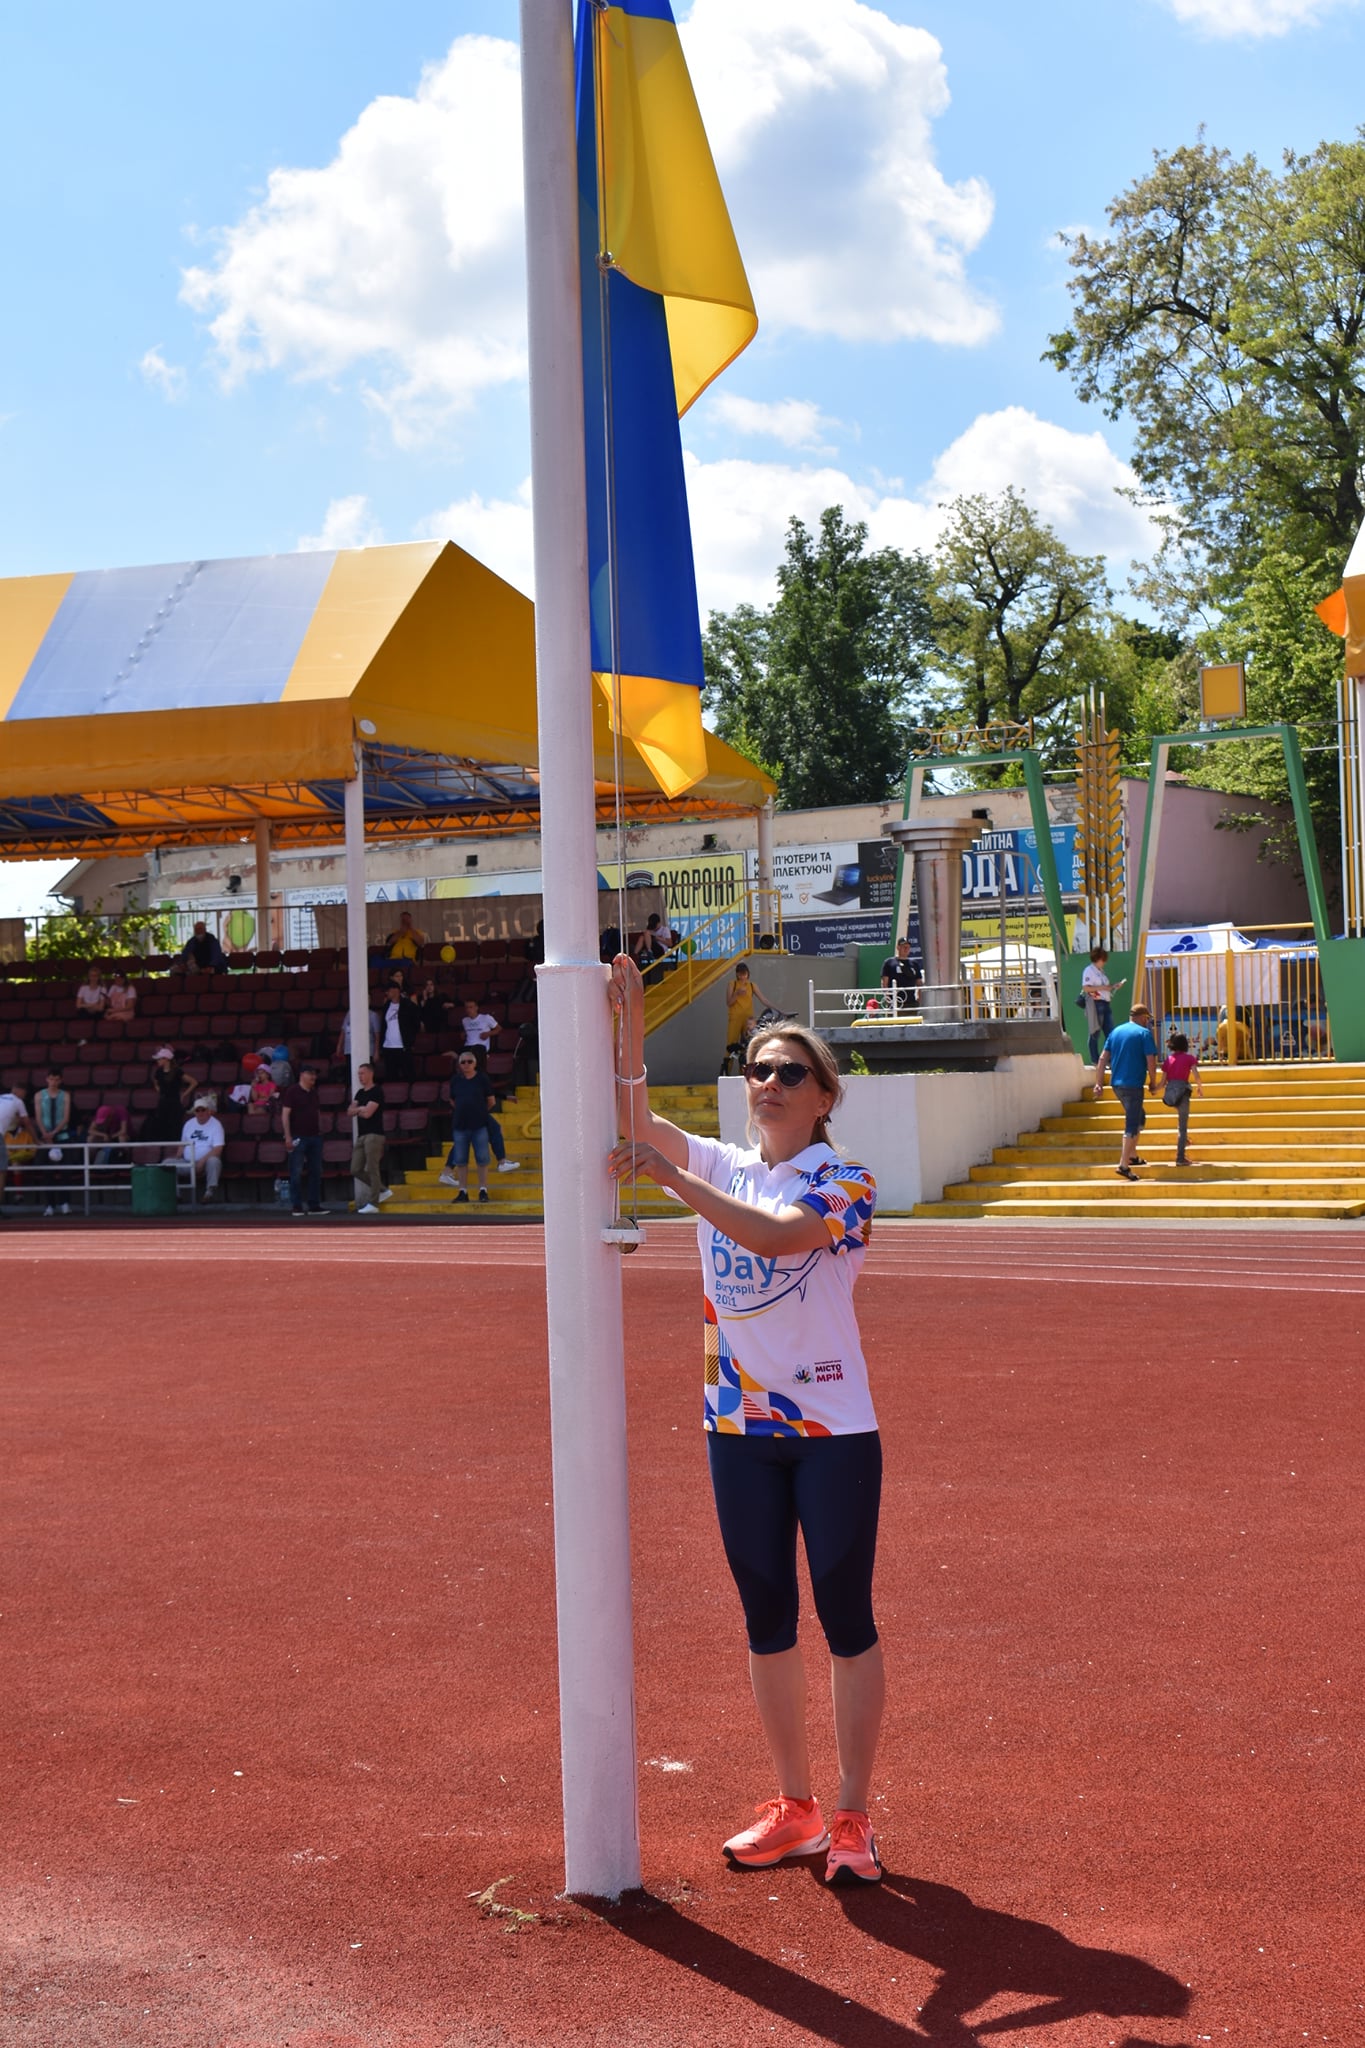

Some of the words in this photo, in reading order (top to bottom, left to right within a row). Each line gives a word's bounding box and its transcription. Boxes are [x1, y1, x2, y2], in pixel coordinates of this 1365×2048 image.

[976, 833, 1014, 851] ПИТНА
[754, 852, 817, 867] КП'ЮТЕРИ
[820, 851, 832, 862] ТА
[754, 863, 832, 880] КПЛЕКТУЮЧІ
[962, 853, 1018, 898] ОДА
[658, 865, 735, 910] ОХОРОНА
[711, 1245, 777, 1288] Day
[815, 1363, 842, 1373] МІСТО
[816, 1370, 844, 1383] МРІЙ
